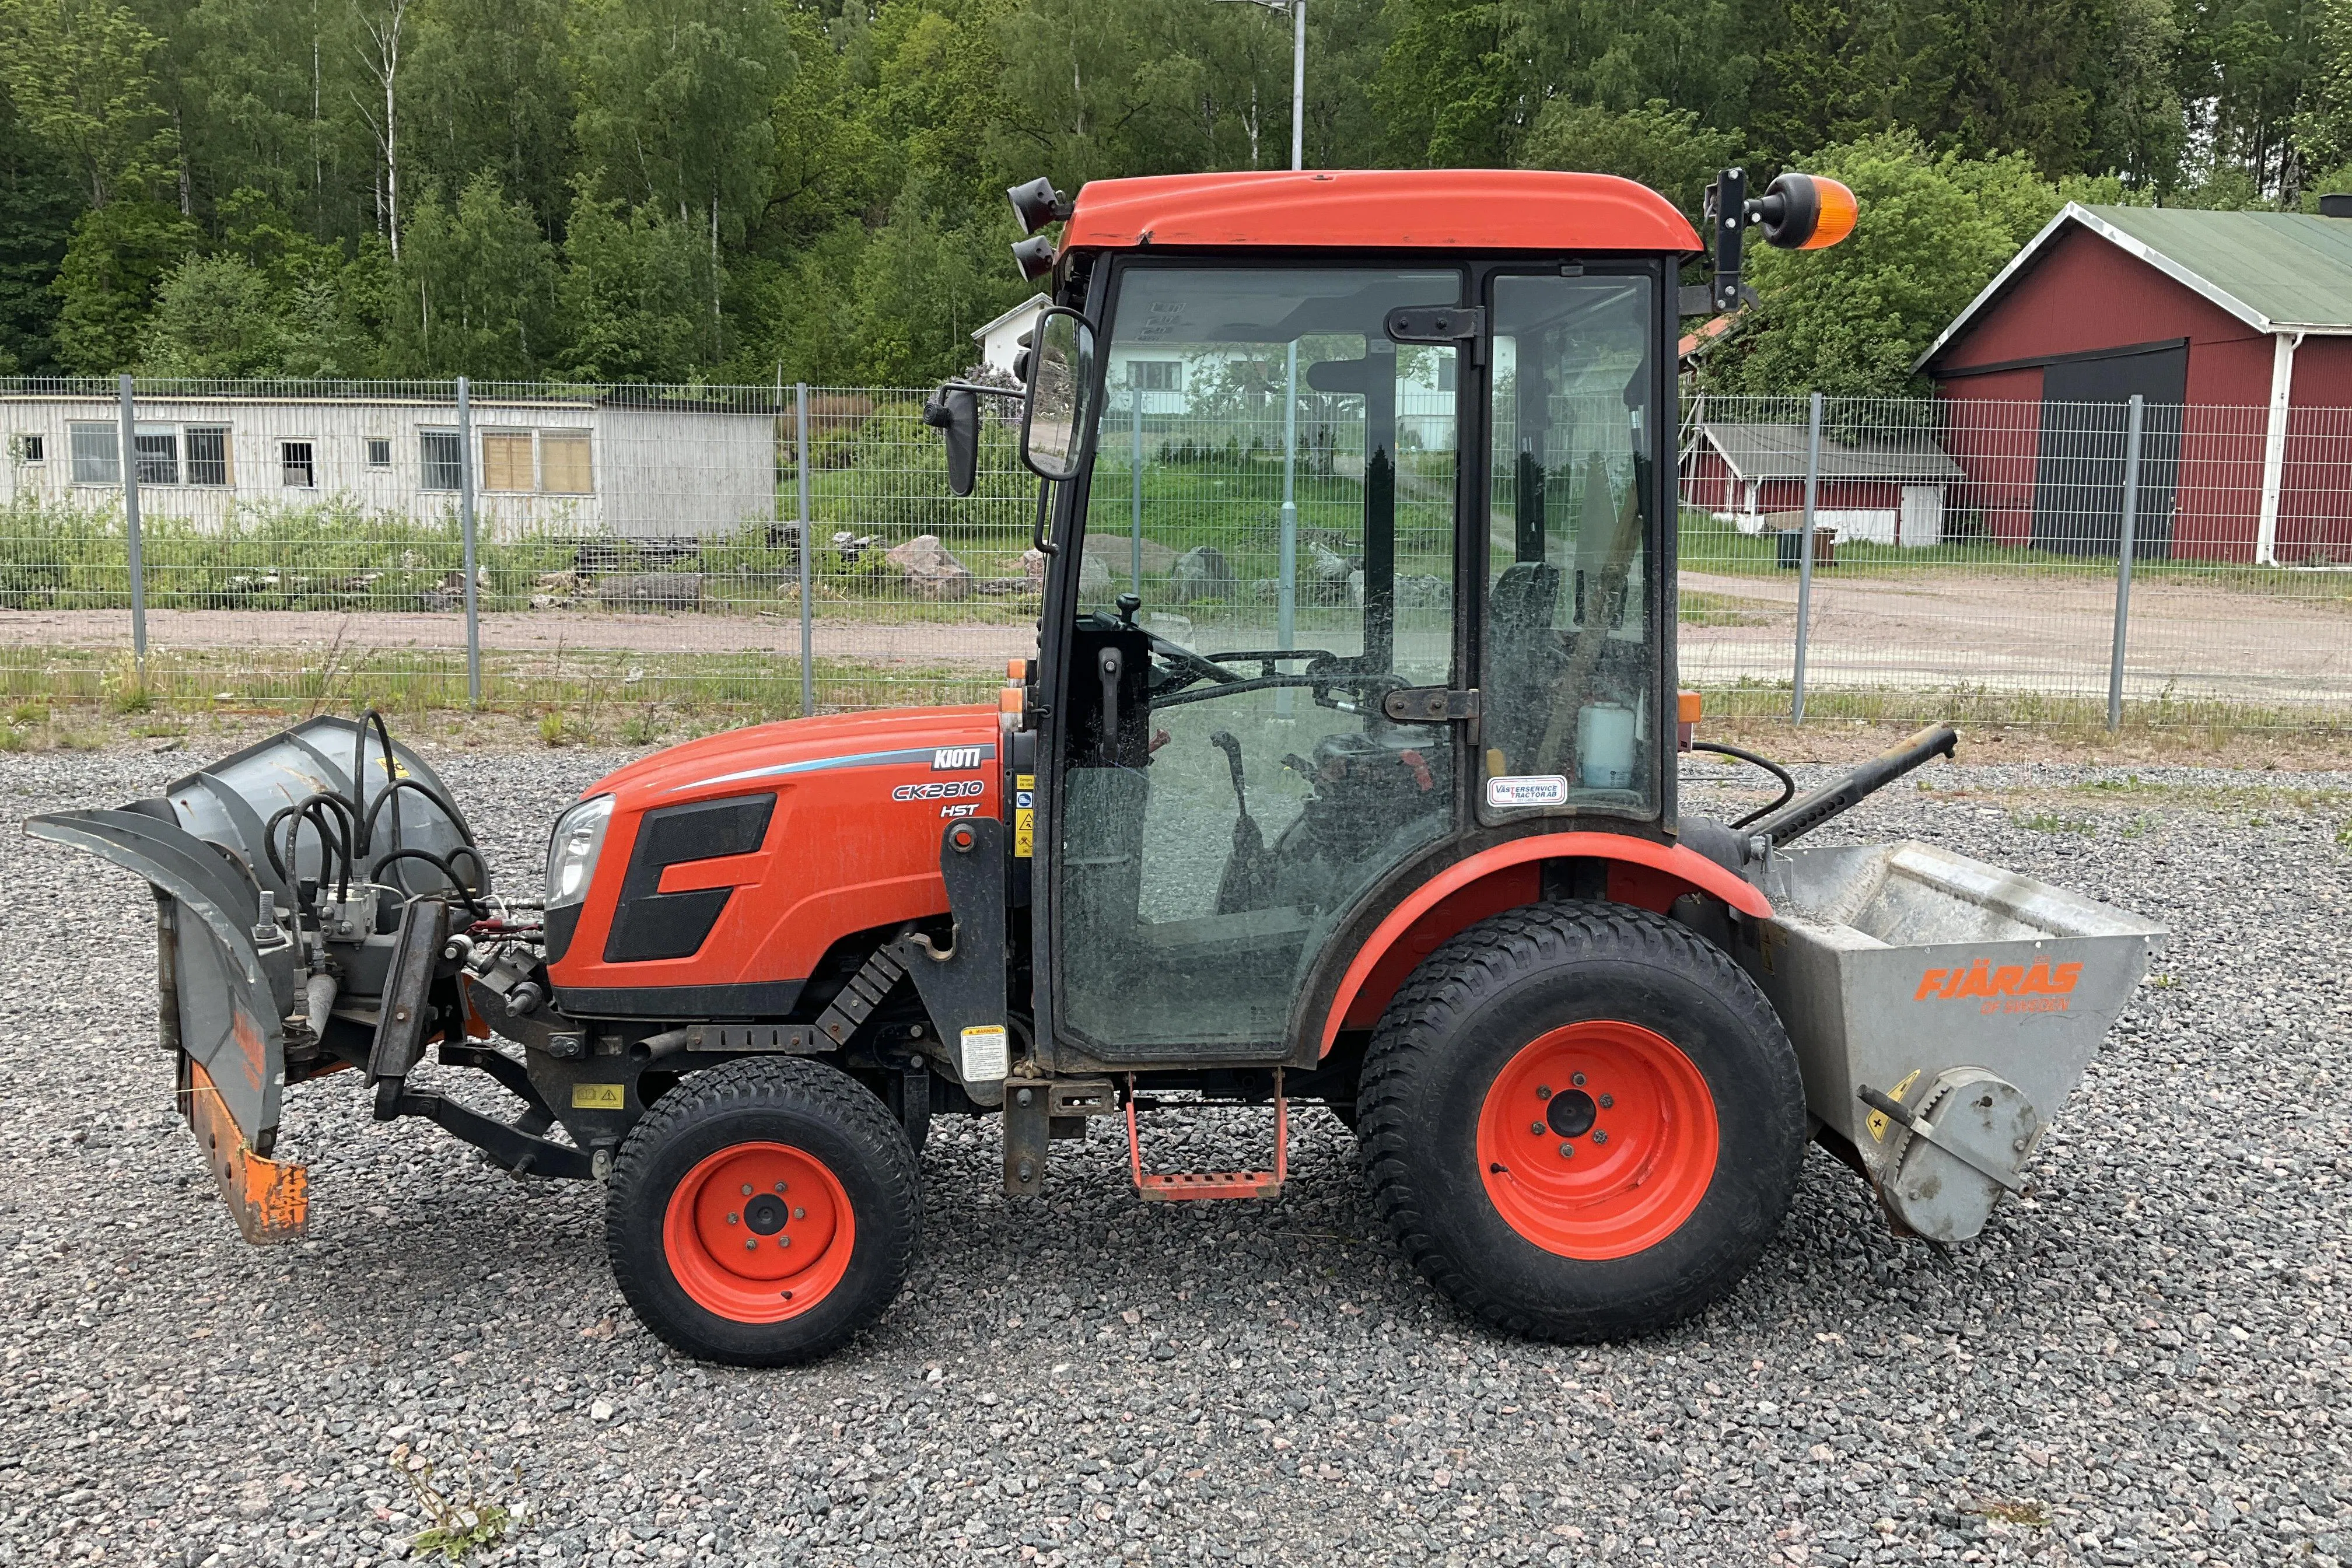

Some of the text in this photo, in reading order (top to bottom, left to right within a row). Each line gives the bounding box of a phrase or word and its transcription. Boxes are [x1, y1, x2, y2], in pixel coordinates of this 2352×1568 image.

[935, 748, 980, 769] KIOTI
[892, 780, 984, 801] CK2810
[1496, 785, 1557, 794] VÄSTERSERVICE
[940, 804, 981, 817] HST
[1913, 955, 2084, 1001] FJÄRÅS
[2003, 996, 2070, 1013] SWEDEN
